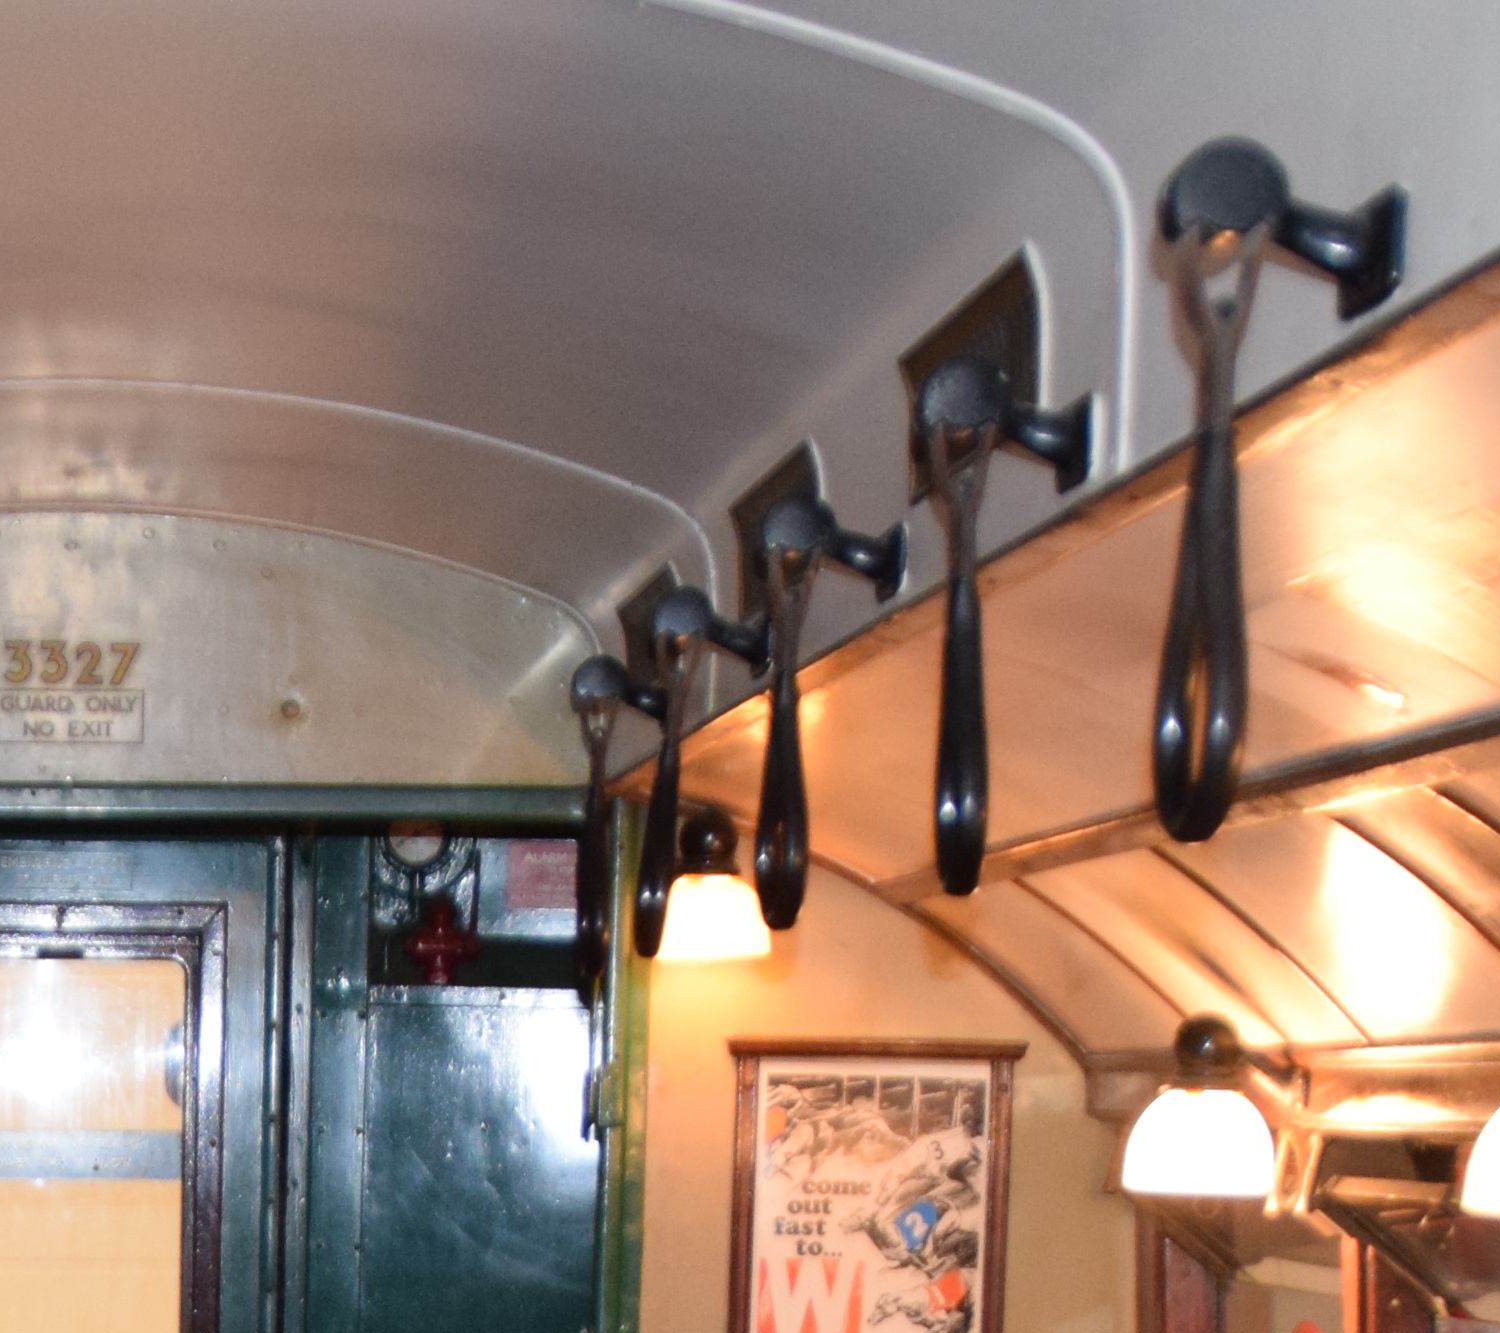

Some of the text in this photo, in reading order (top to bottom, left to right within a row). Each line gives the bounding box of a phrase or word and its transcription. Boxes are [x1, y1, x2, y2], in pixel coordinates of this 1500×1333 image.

[4, 640, 140, 684] 3327
[0, 695, 137, 712] GUARD ONLY
[23, 720, 112, 737] NO EXIT
[802, 1179, 872, 1195] come
[787, 1197, 832, 1214] out
[774, 1217, 827, 1236] fast
[904, 1210, 930, 1238] 2
